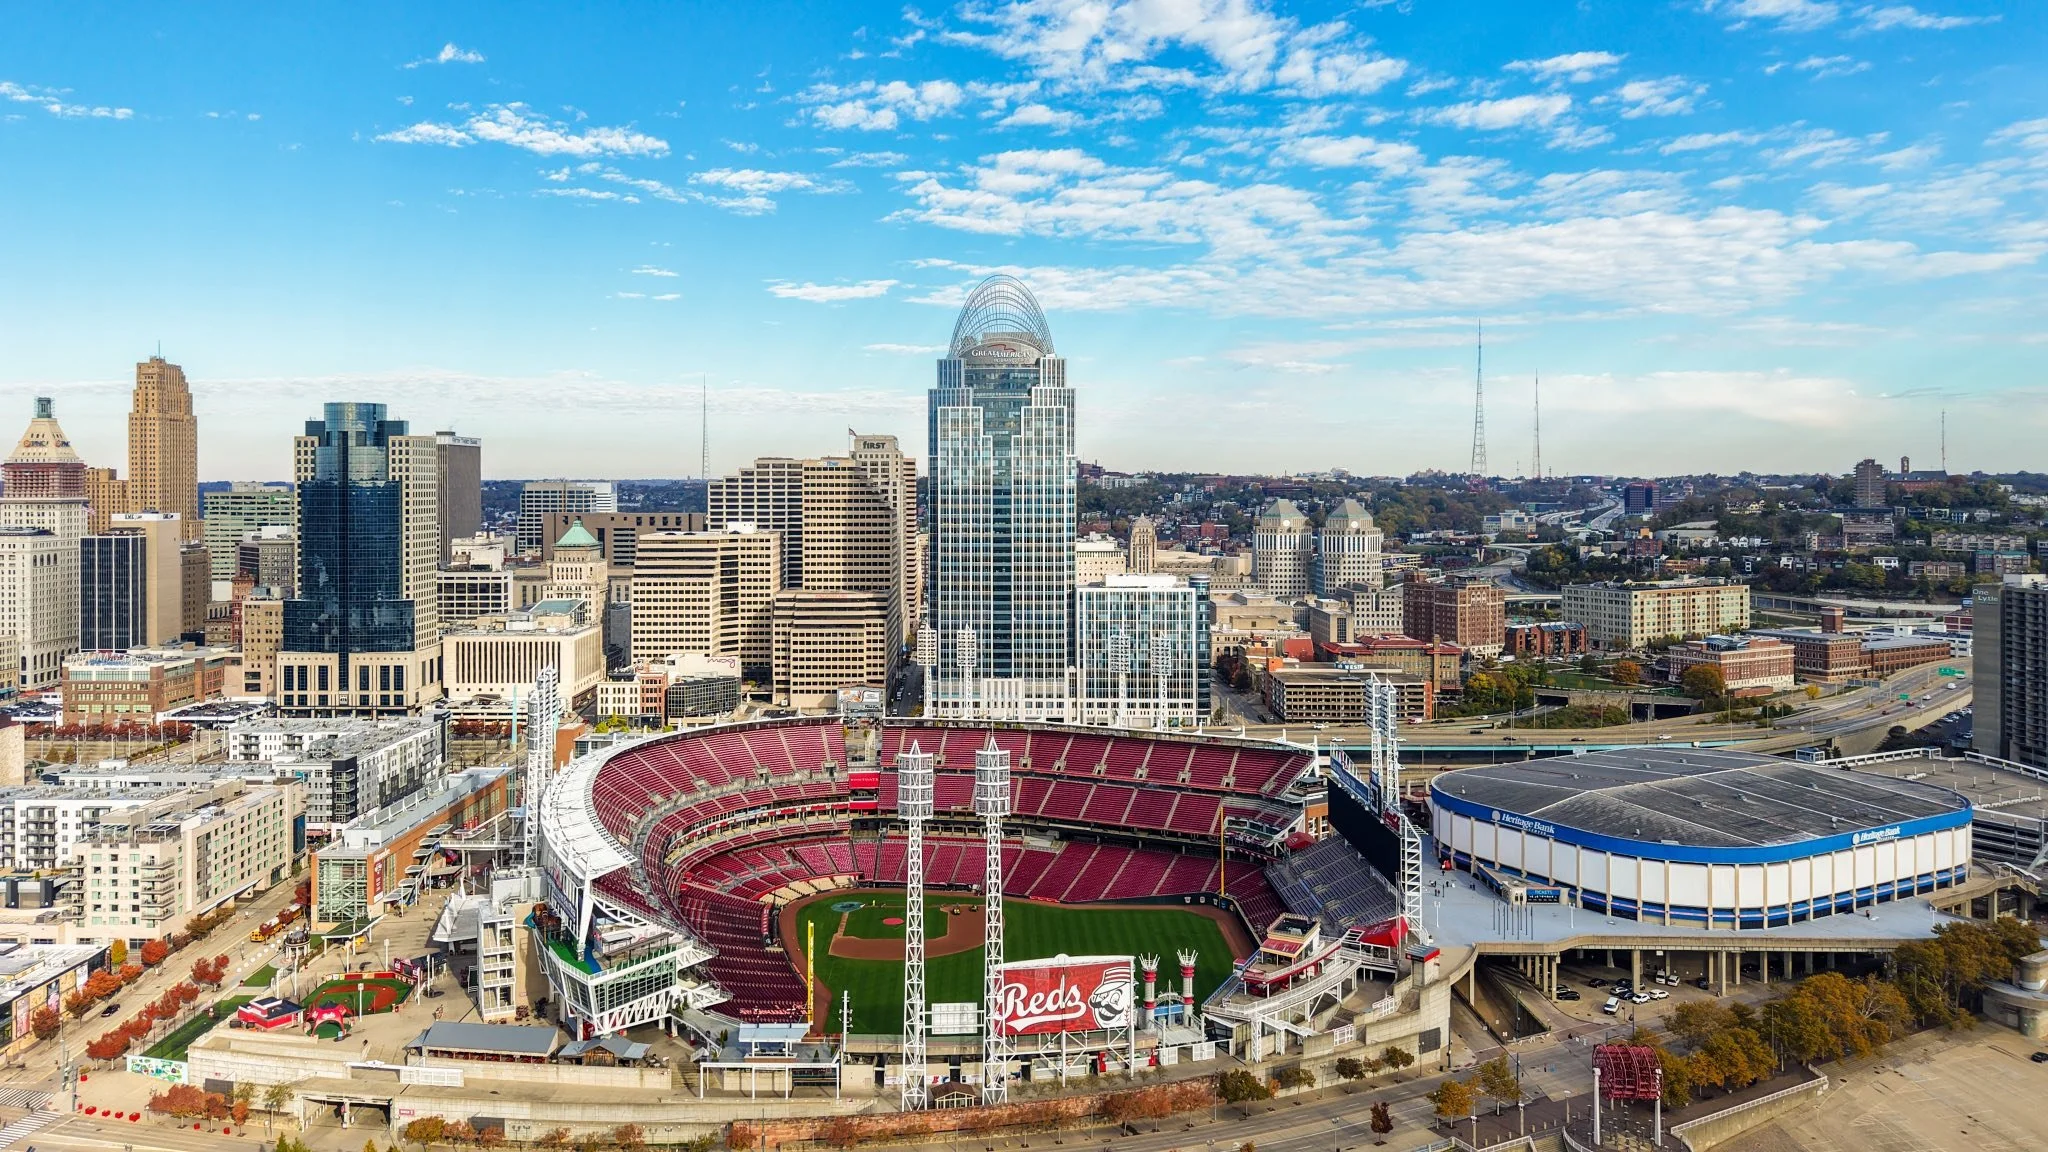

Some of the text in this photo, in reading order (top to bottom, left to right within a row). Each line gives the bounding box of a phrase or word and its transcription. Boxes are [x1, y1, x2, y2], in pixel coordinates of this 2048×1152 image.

[1502, 813, 1555, 834] Heritage Bank
[996, 974, 1087, 1024] Reds
